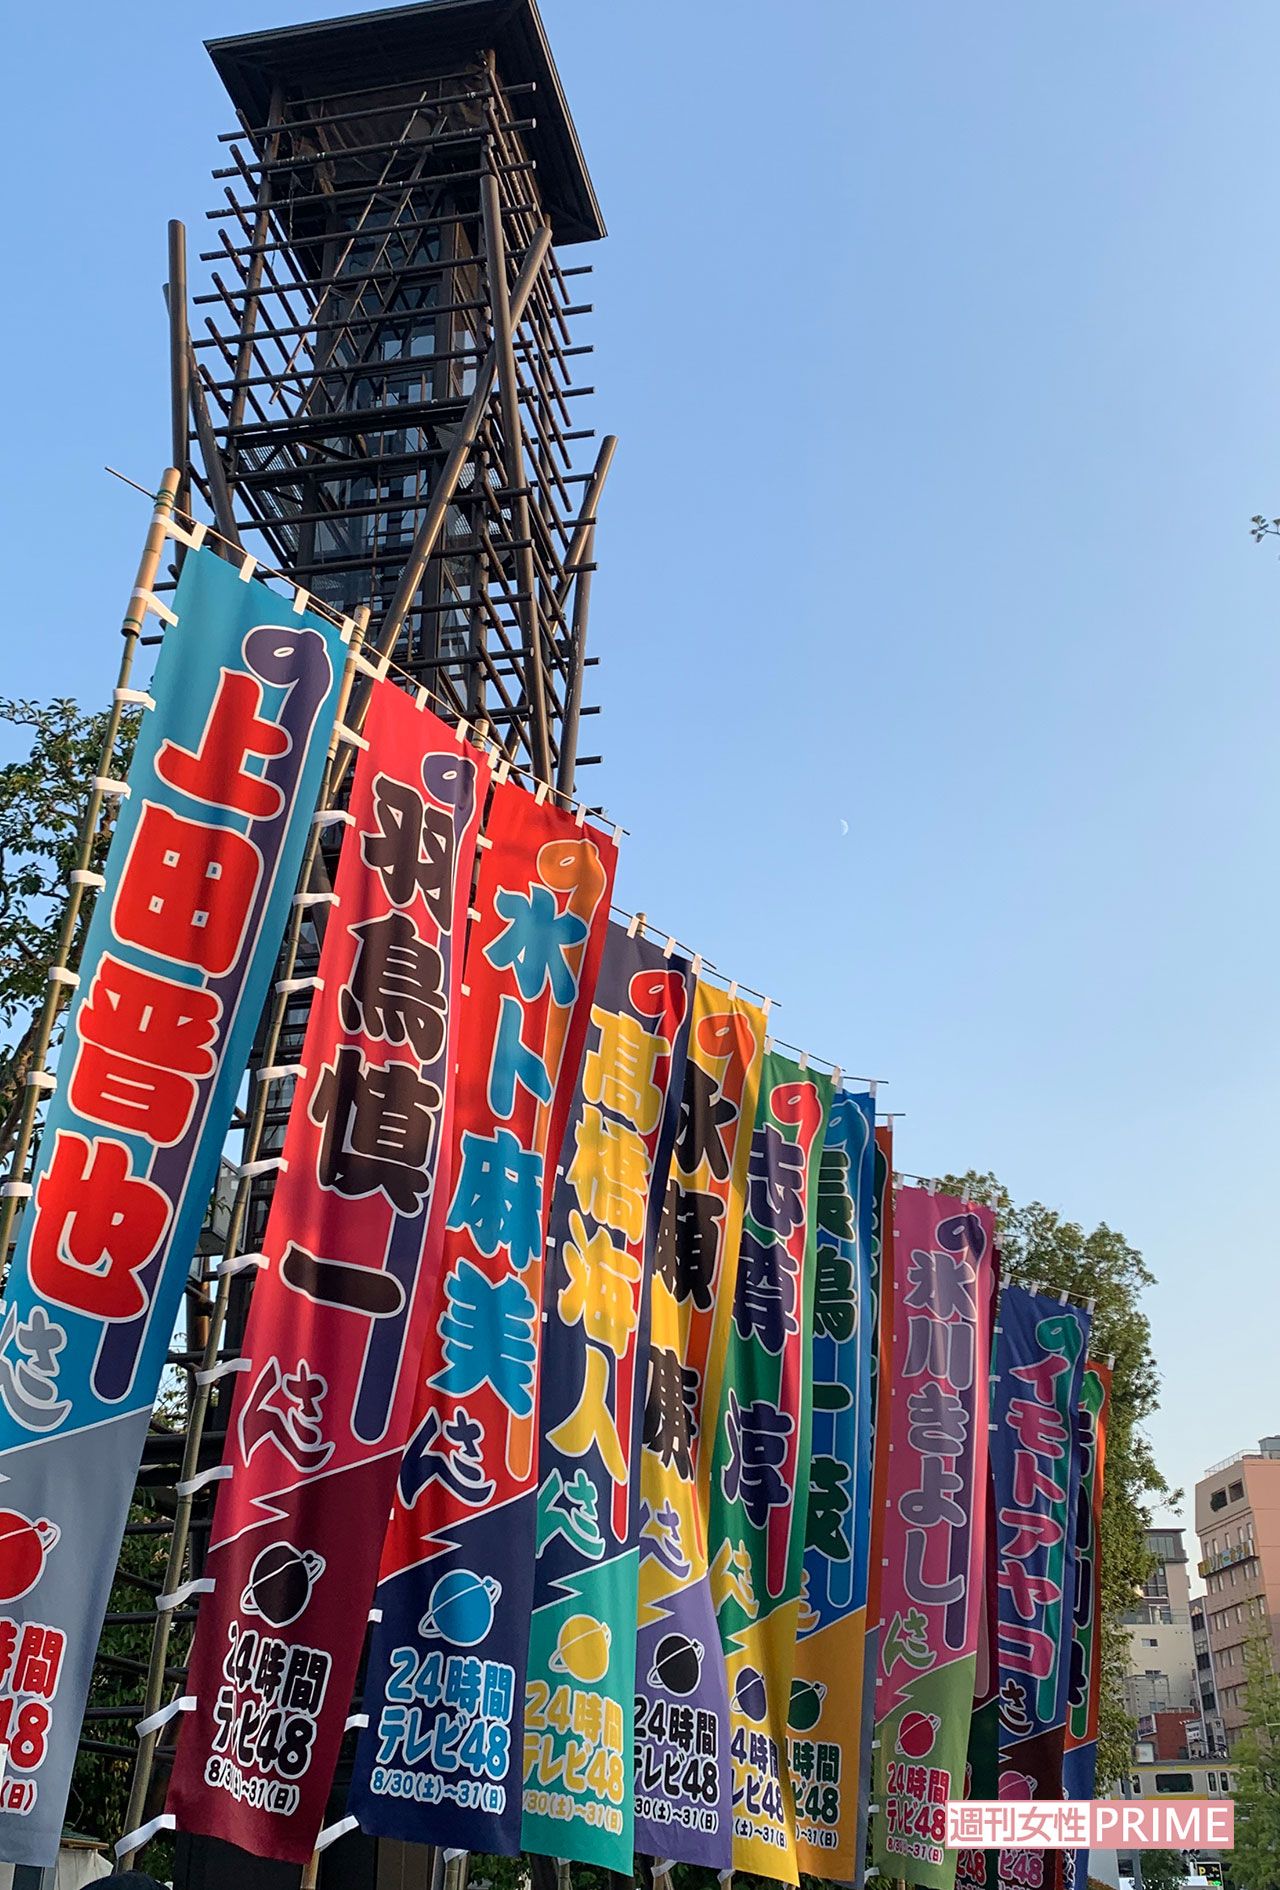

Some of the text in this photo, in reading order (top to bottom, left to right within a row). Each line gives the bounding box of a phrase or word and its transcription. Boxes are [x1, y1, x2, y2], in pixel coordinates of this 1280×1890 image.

[386, 1646, 515, 1725] 24時間
[524, 1680, 624, 1756] 24時間
[212, 1686, 317, 1780] テビ48
[376, 1705, 510, 1780] テレビ48
[634, 1694, 718, 1760] 24時間
[523, 1733, 624, 1805] テレビ48
[886, 1761, 951, 1806] 24時間
[886, 1798, 946, 1844] テレビ48
